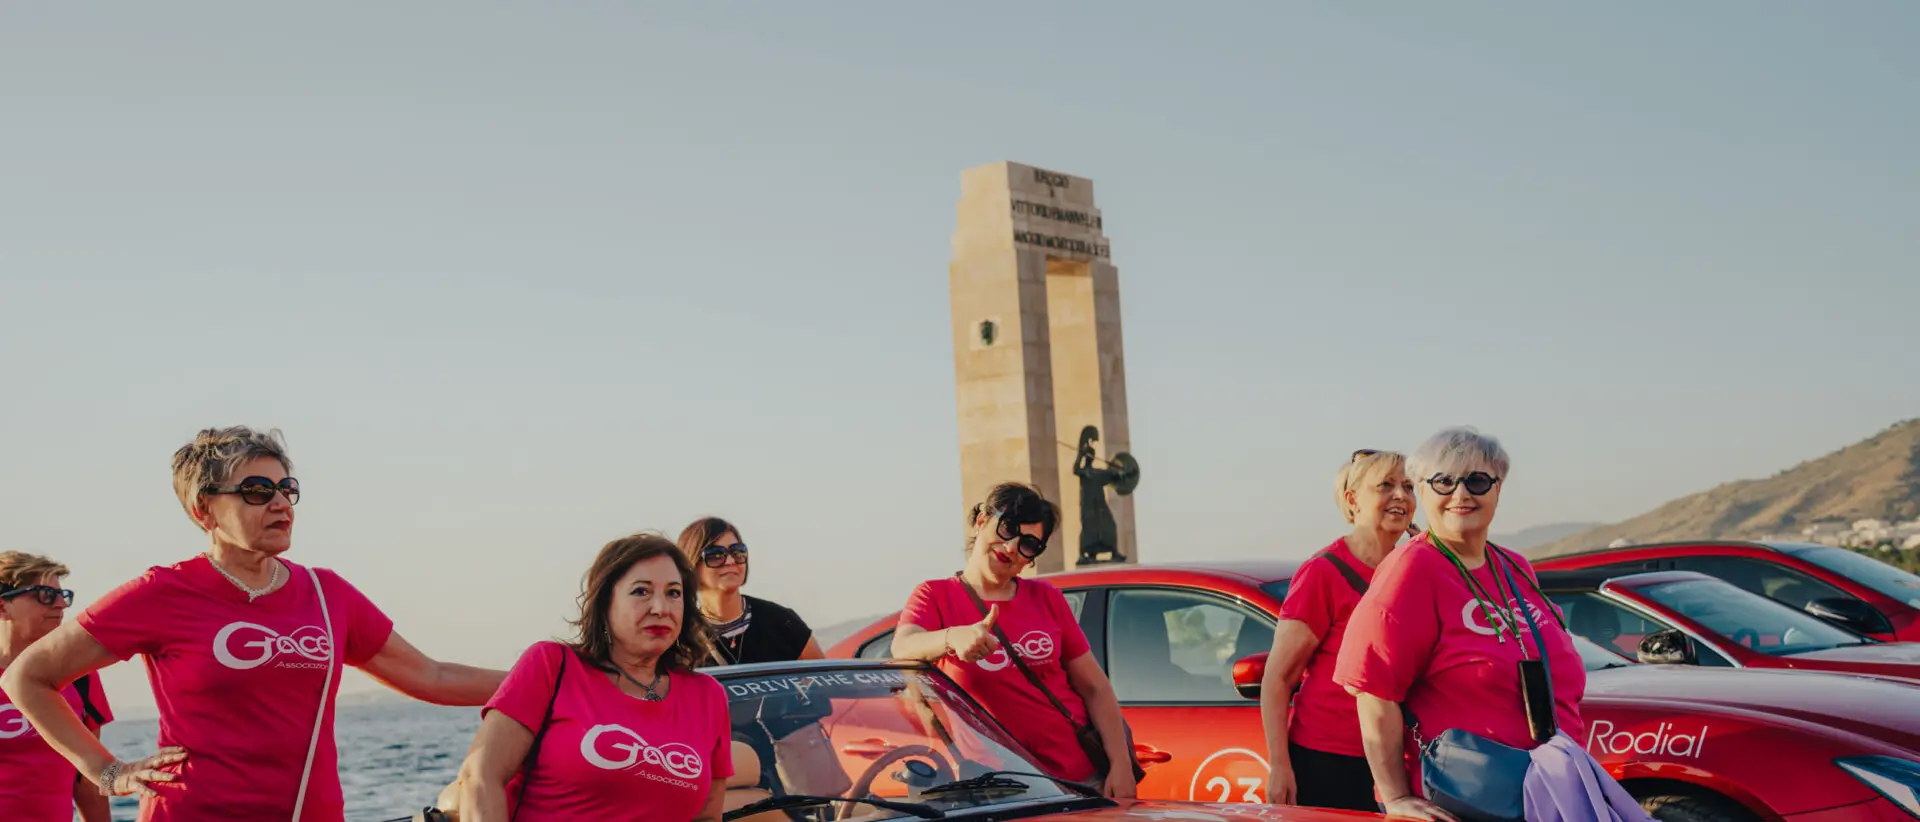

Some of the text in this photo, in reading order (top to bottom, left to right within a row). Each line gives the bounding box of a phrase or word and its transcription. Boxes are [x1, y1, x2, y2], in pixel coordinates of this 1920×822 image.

[213, 621, 331, 669] Grace
[275, 660, 329, 670] Associazion
[728, 672, 940, 697] DRIVE THE CHANE!
[580, 723, 703, 779] Grace
[1586, 719, 1708, 759] Rodial
[1205, 776, 1263, 804] 23
